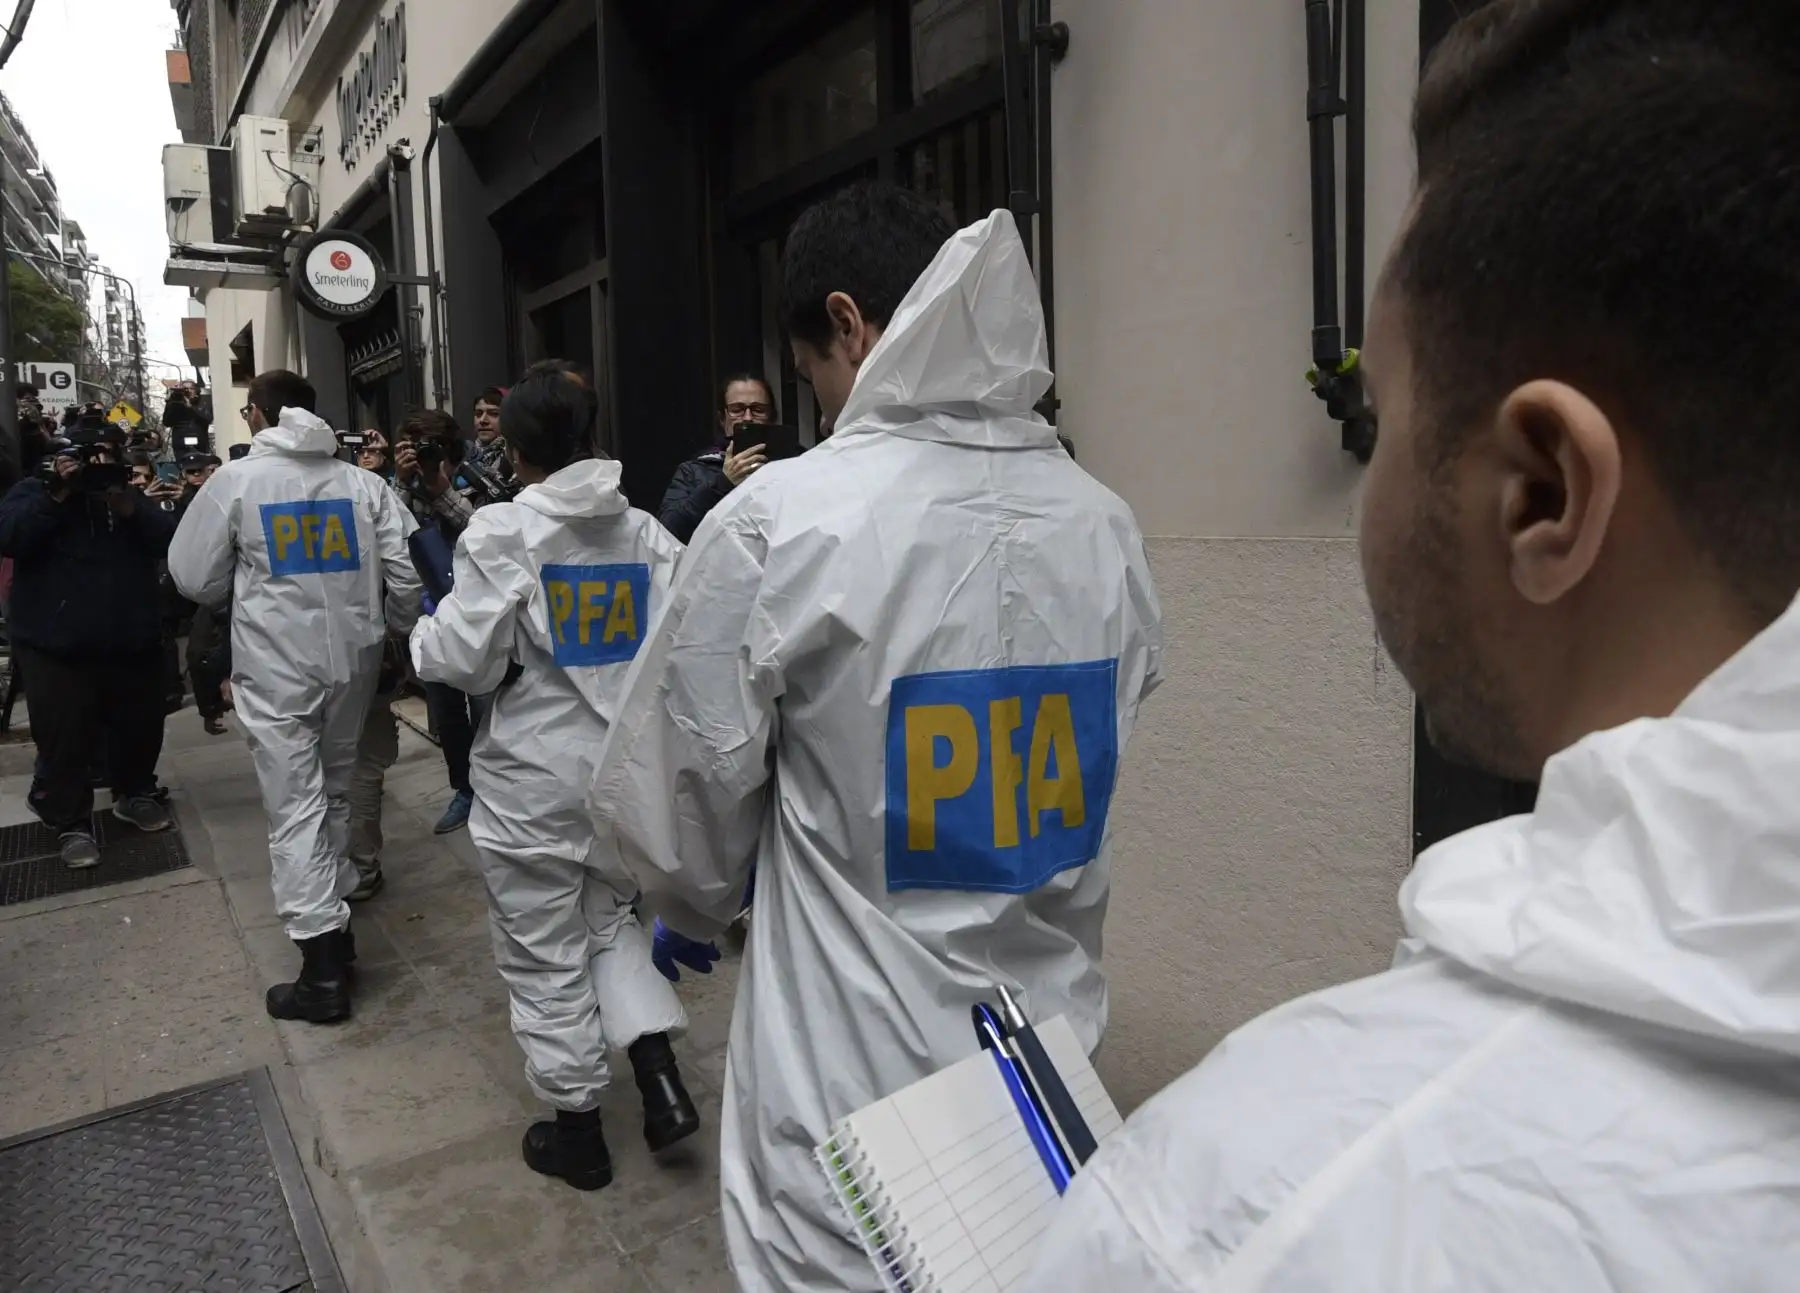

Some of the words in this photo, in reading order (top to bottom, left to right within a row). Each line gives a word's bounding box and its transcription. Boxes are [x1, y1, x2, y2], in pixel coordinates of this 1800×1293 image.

[315, 271, 369, 291] Smeterling
[55, 374, 66, 386] E
[271, 513, 351, 561] PFA
[548, 580, 637, 645] PFA
[905, 693, 1085, 851] PFA
